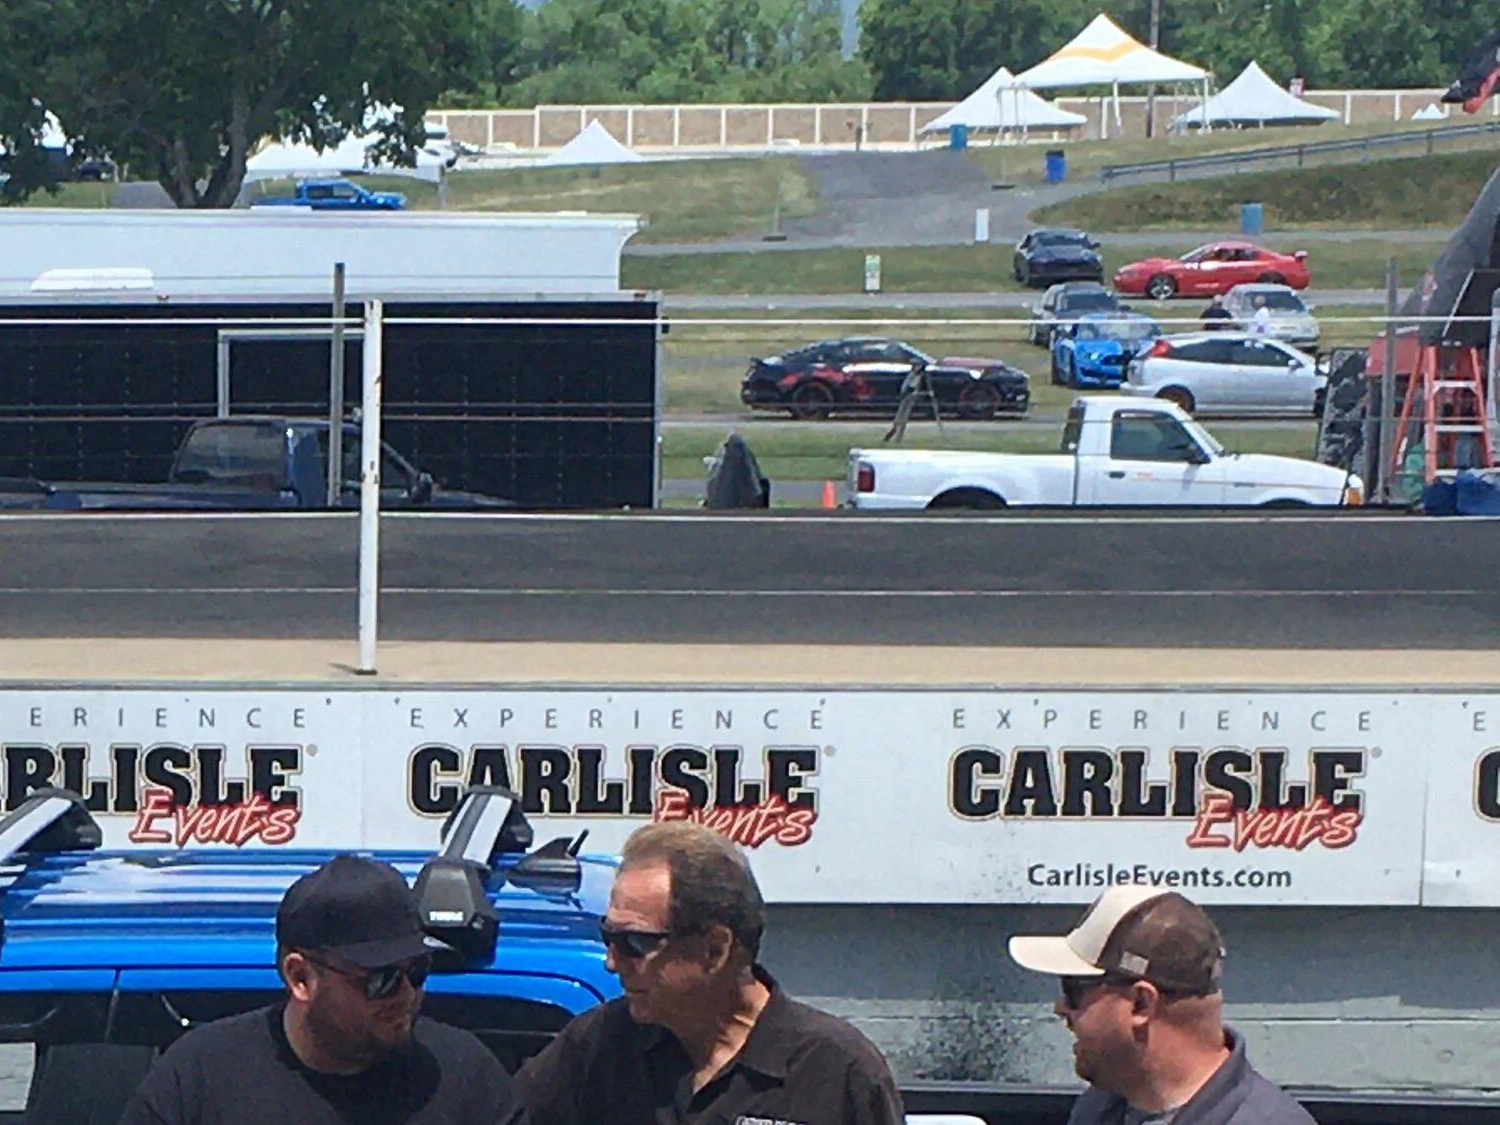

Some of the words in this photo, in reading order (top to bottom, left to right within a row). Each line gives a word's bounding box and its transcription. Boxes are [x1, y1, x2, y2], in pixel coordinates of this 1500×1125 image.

[409, 707, 824, 731] EXPERIENCE
[951, 708, 1371, 733] EXPERIENCE
[410, 745, 818, 815] CARLISLE
[953, 748, 1364, 817] CARLISLE
[130, 790, 299, 845] Events
[1187, 795, 1363, 852] Events
[1027, 863, 1292, 889] CarlisleEvents.com
